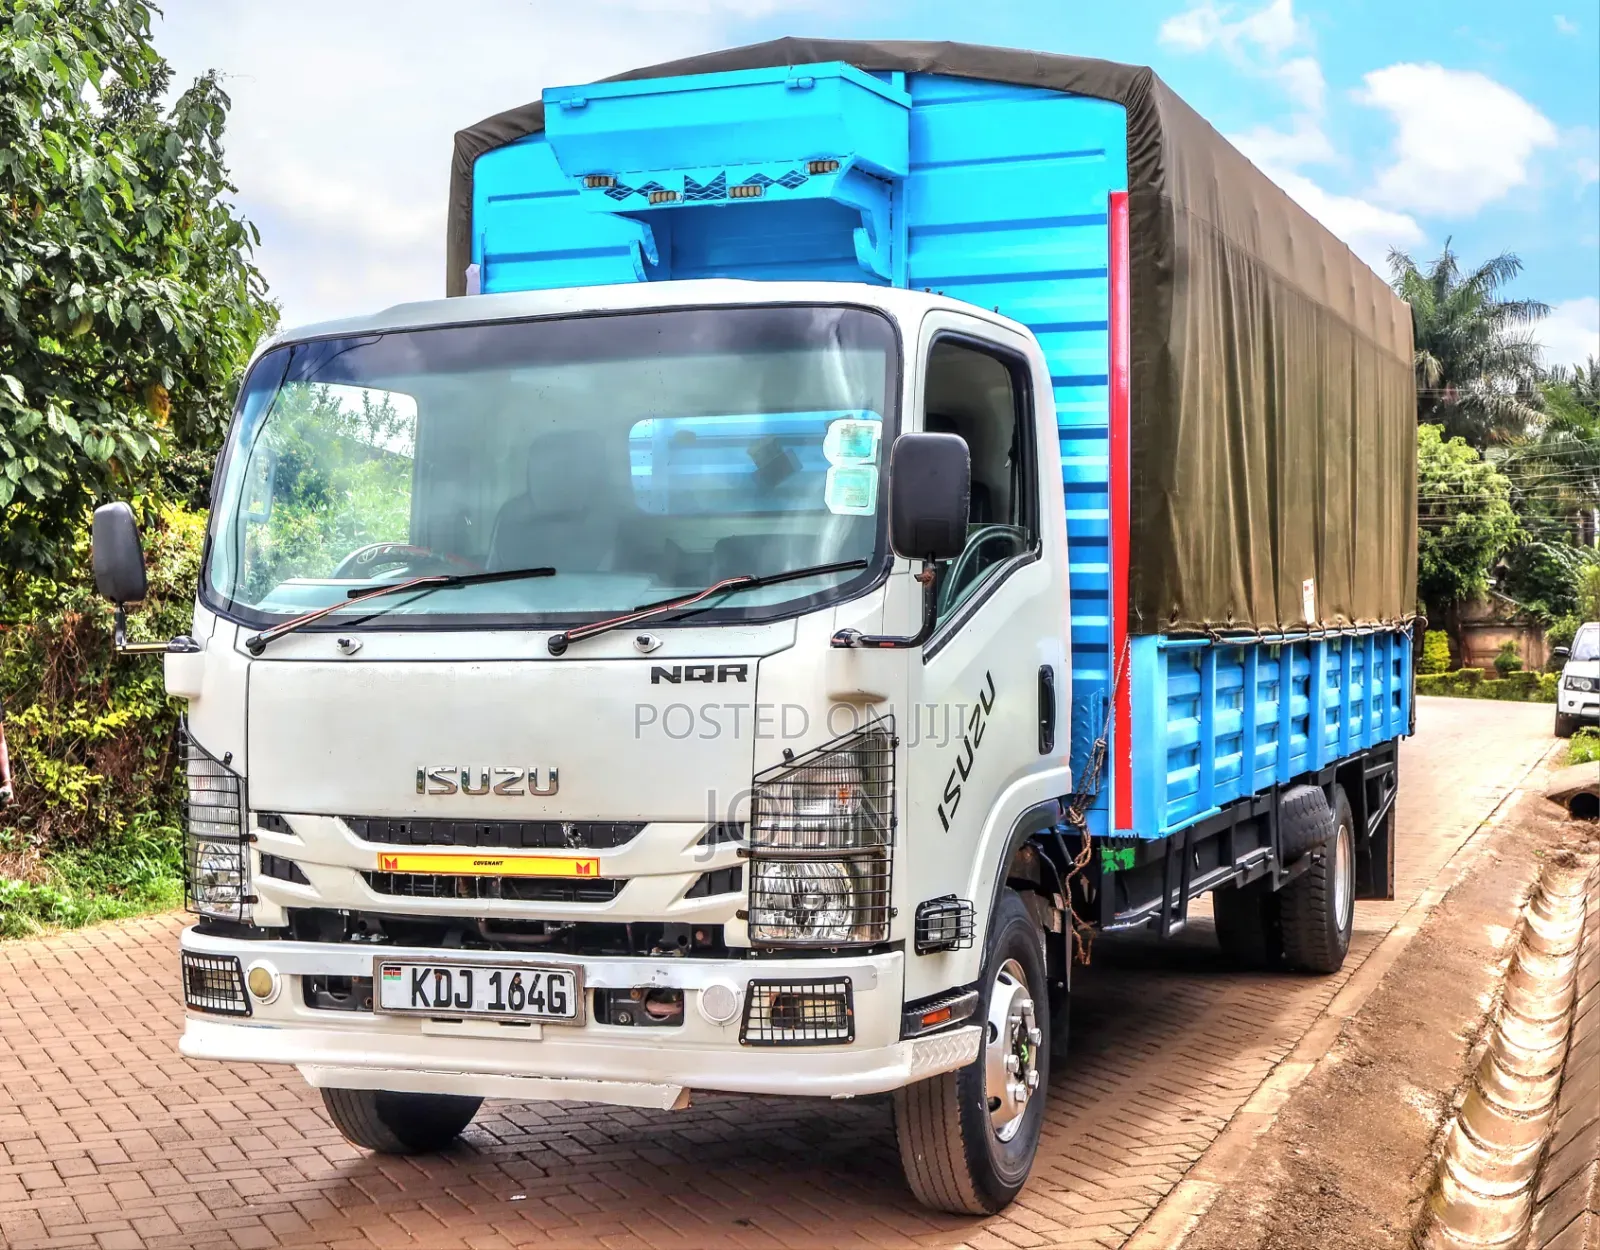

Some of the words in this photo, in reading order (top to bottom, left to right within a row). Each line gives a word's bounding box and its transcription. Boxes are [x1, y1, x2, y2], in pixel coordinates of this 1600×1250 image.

[650, 663, 748, 684] NQR
[937, 669, 996, 833] ISUZU
[416, 765, 559, 796] ISUZU
[411, 967, 473, 1009] KDJ
[487, 971, 567, 1014] 164G
